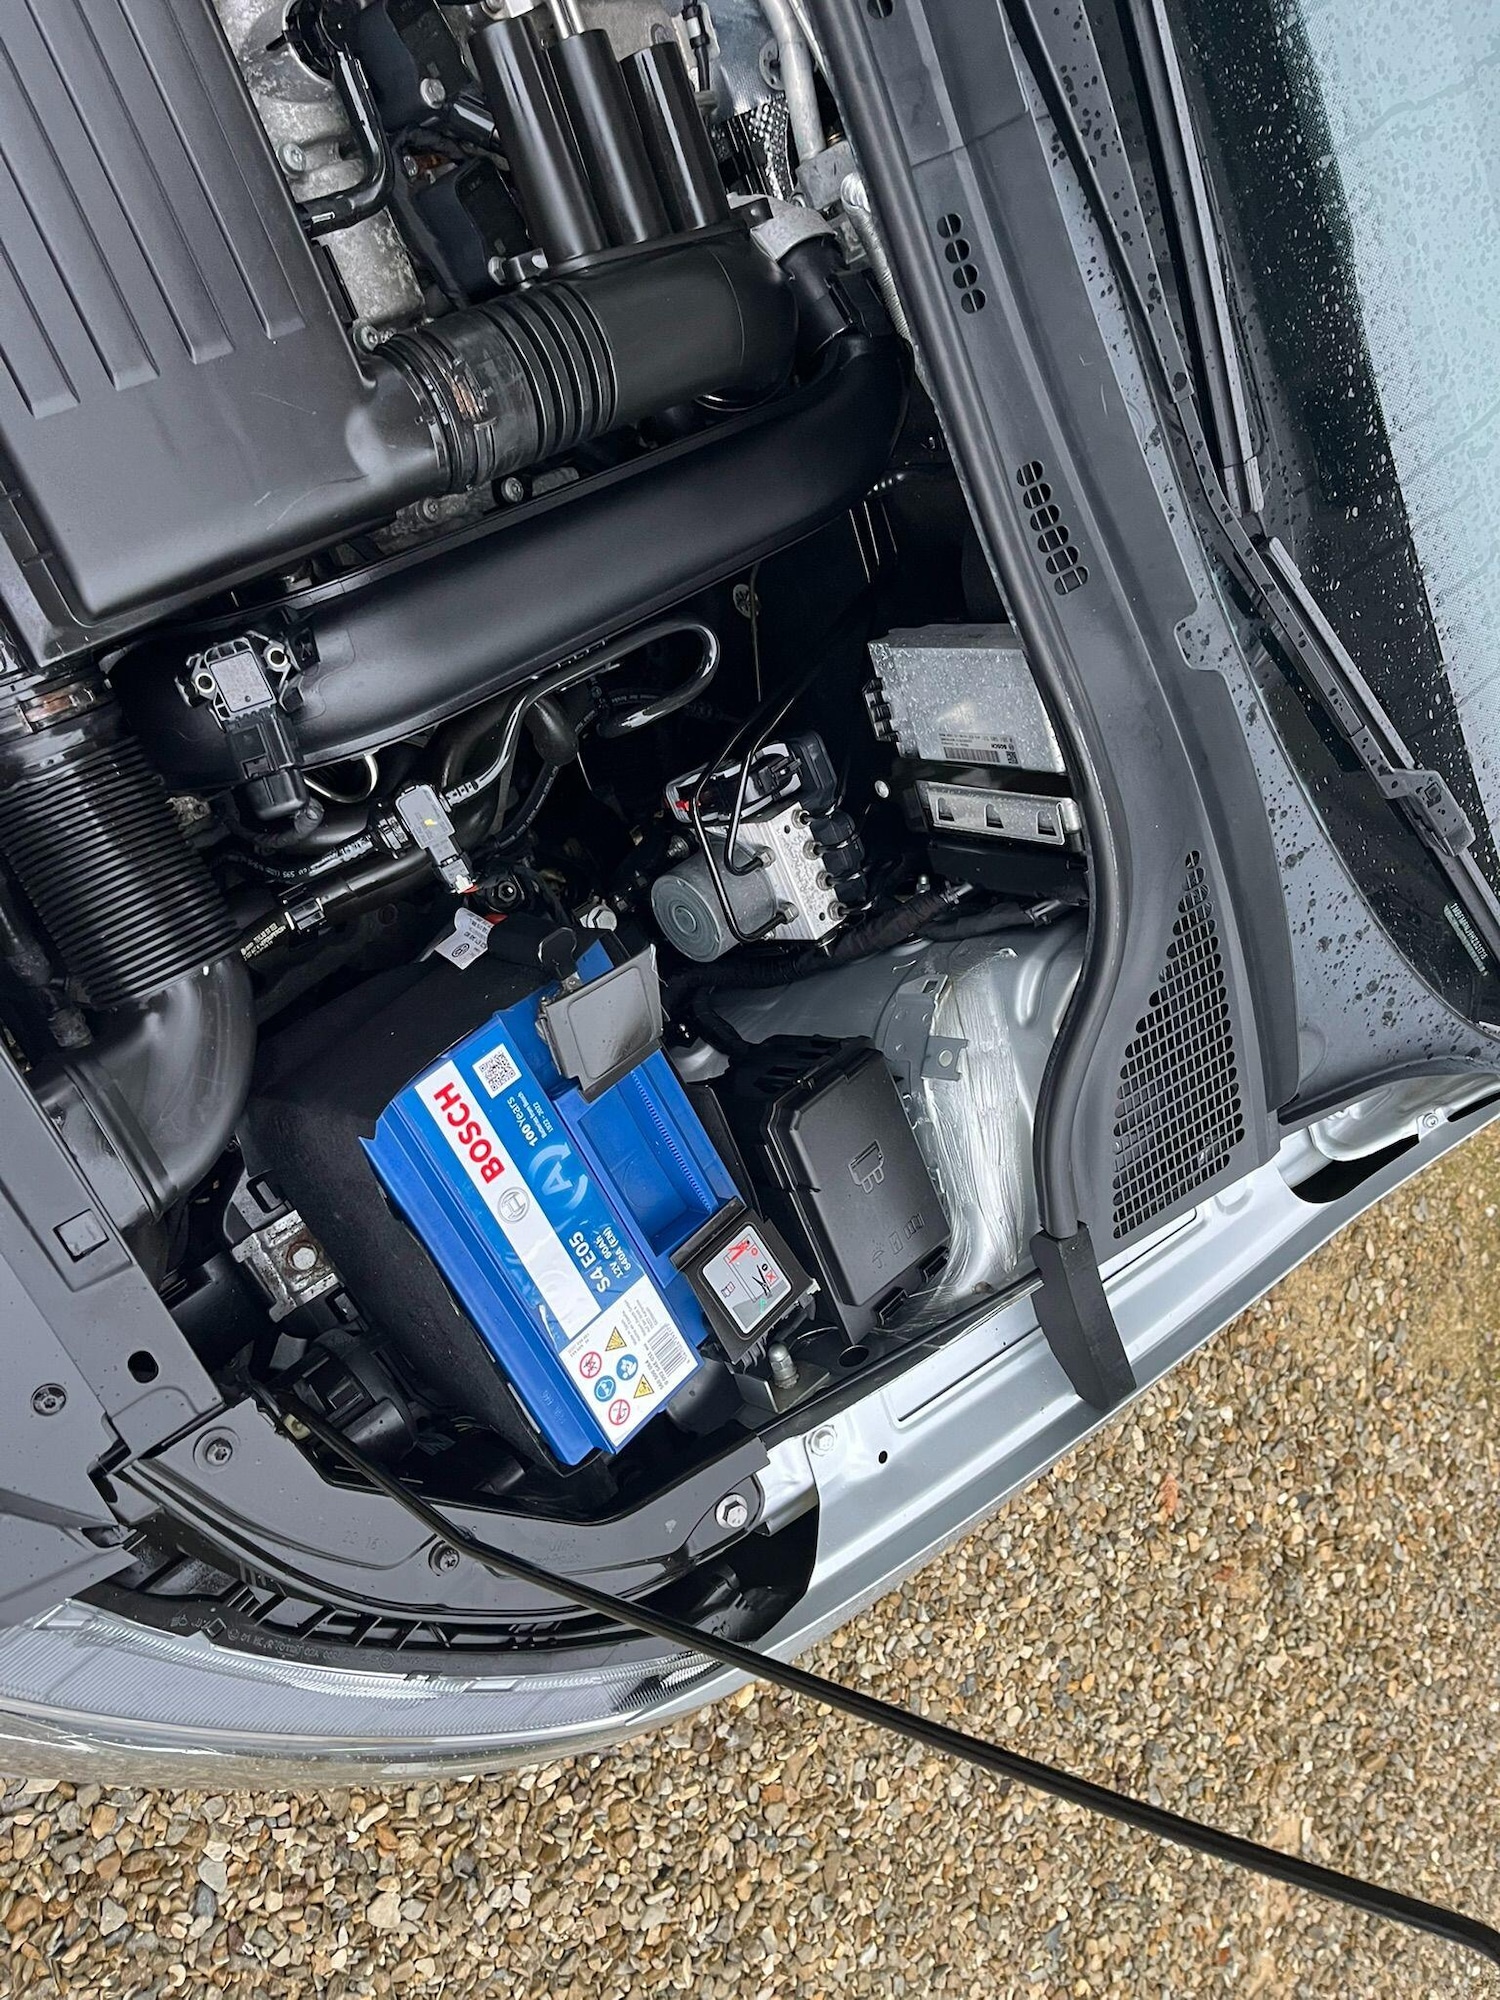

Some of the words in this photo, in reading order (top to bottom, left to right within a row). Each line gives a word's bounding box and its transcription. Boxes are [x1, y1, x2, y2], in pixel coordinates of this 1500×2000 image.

[524, 1104, 536, 1119] from
[531, 1100, 544, 1116] 2022
[434, 1082, 505, 1184] BOSCH
[541, 1117, 554, 1133] 1922
[603, 1226, 619, 1248] (EN)
[569, 1232, 595, 1268] E05
[595, 1237, 611, 1260] 60Ah
[614, 1247, 632, 1270] 640A
[589, 1265, 612, 1293] S4
[610, 1261, 624, 1279] 12V
